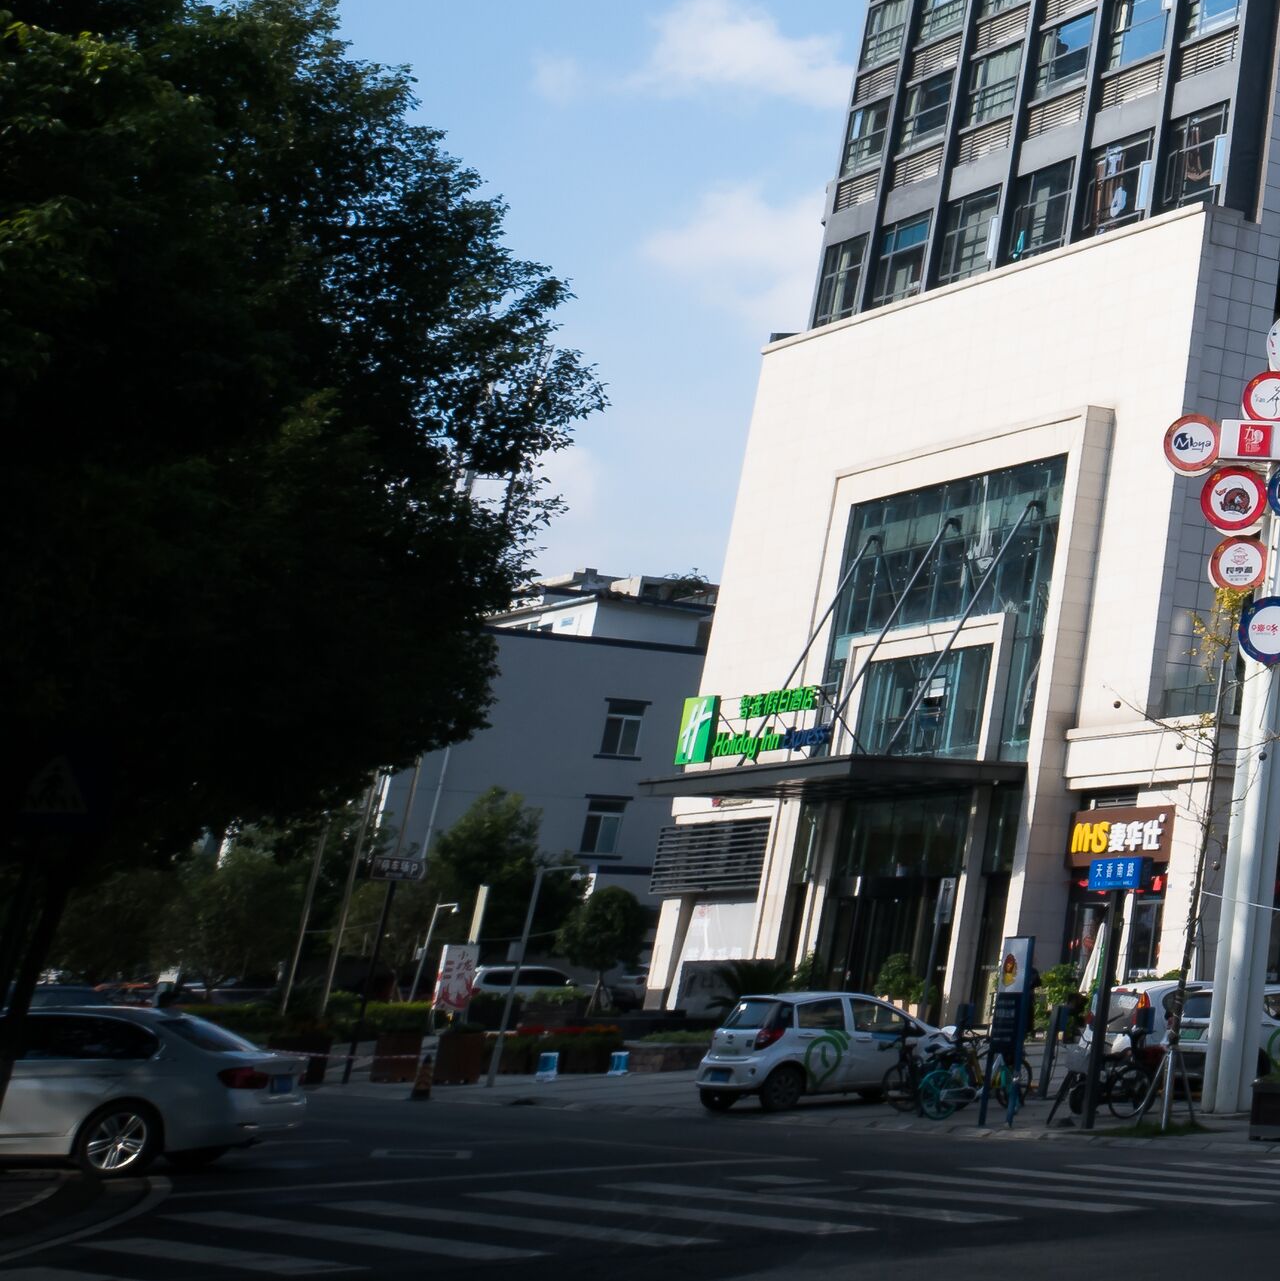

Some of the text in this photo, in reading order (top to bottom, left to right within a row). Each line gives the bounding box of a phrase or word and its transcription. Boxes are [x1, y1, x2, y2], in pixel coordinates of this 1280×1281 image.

[740, 686, 818, 719] 智选假日酒店
[712, 731, 760, 760] Holiday
[760, 727, 783, 752] Inn
[782, 726, 831, 751] Express
[1071, 820, 1163, 853] MHS 麦华仕
